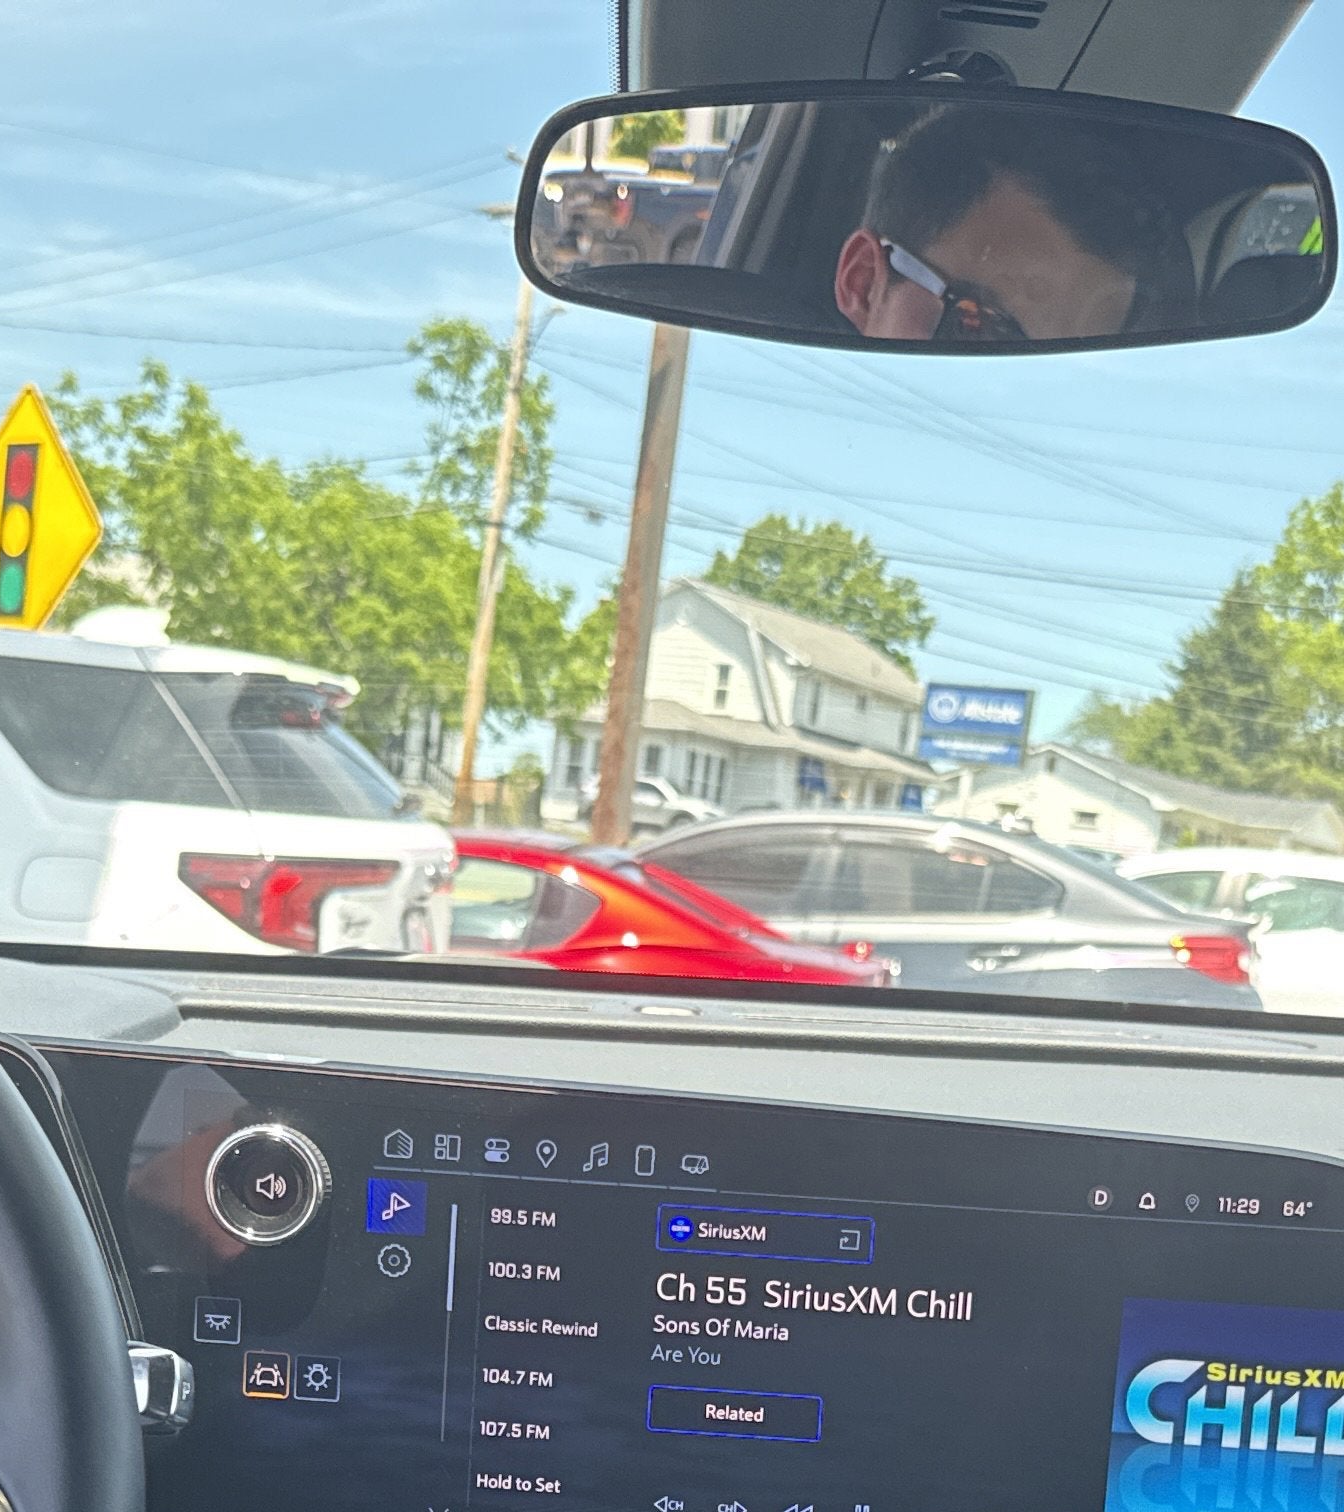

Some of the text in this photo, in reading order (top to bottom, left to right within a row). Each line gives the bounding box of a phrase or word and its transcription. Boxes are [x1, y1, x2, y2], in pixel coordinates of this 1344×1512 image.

[1094, 1190, 1107, 1205] D
[1218, 1197, 1260, 1215] 11:29
[491, 1208, 556, 1228] 99.5 FM
[1282, 1200, 1313, 1217] 64°
[698, 1222, 766, 1242] SiriusXM
[489, 1262, 561, 1282] 100.3 FM
[656, 1272, 973, 1321] Ch 55 SiriusXM Chill
[485, 1315, 598, 1337] Classic Rewind
[653, 1314, 789, 1341] Sons Of Maria
[651, 1344, 721, 1366] Are You
[482, 1367, 553, 1387] 104.7 FM
[705, 1404, 764, 1423] Related
[480, 1420, 550, 1440] 107.5 FM
[476, 1473, 561, 1494] Hold to Set
